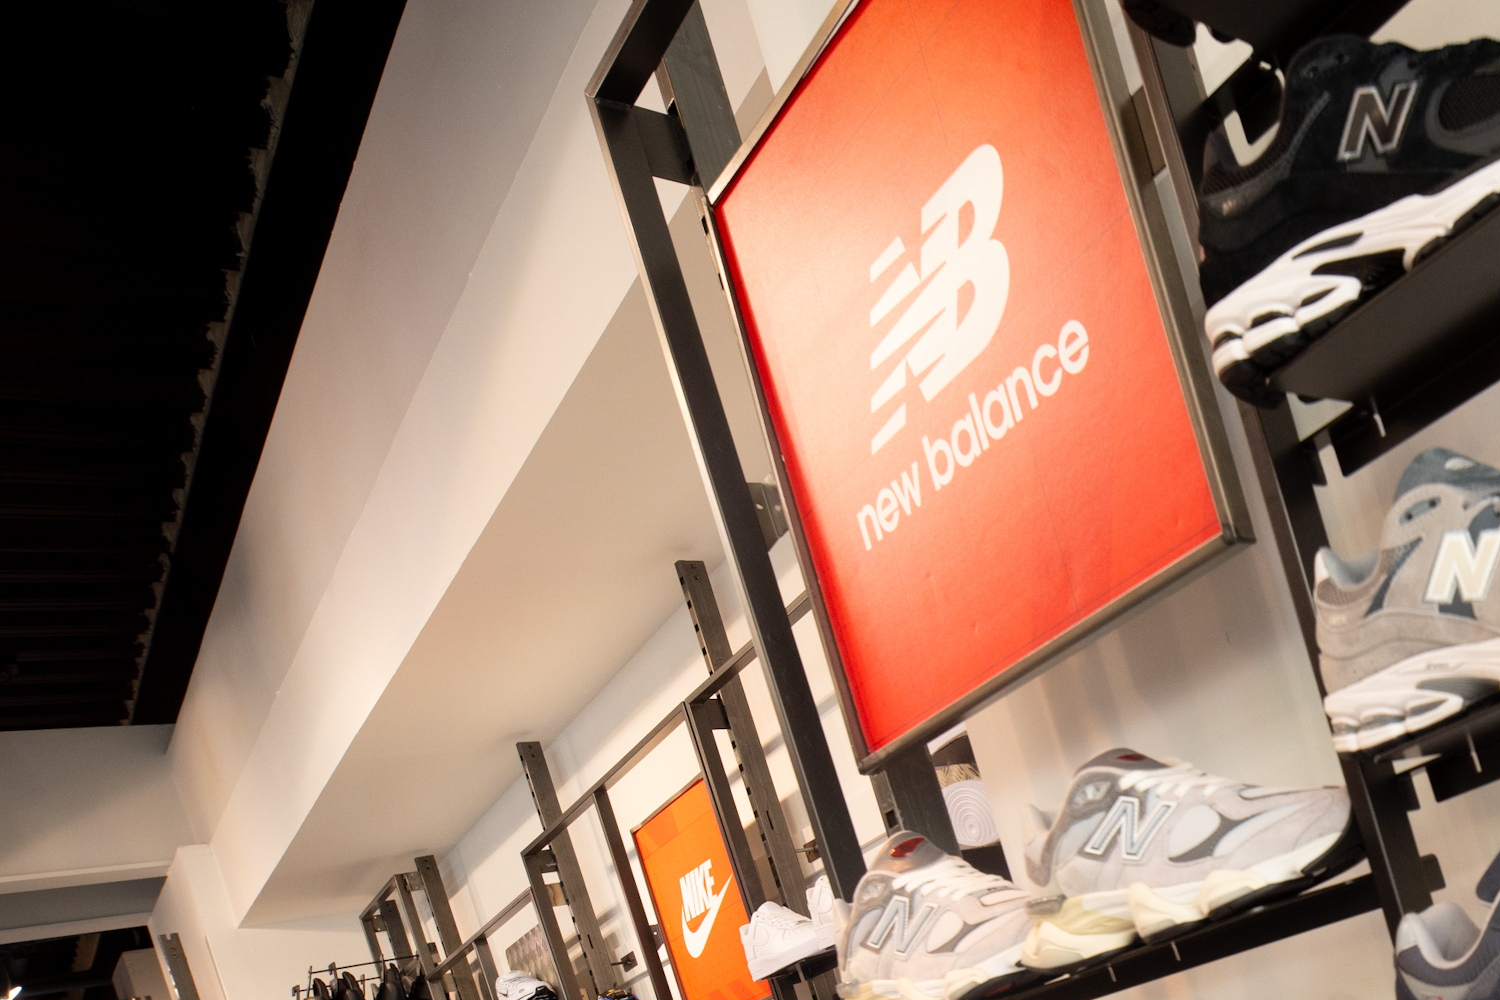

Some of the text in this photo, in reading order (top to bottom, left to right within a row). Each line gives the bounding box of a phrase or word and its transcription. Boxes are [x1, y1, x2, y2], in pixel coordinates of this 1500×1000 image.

[1338, 81, 1417, 161] N
[857, 319, 1090, 551] new balance
[1084, 796, 1176, 861] N
[679, 858, 718, 923] NIKE
[866, 895, 938, 958] N
